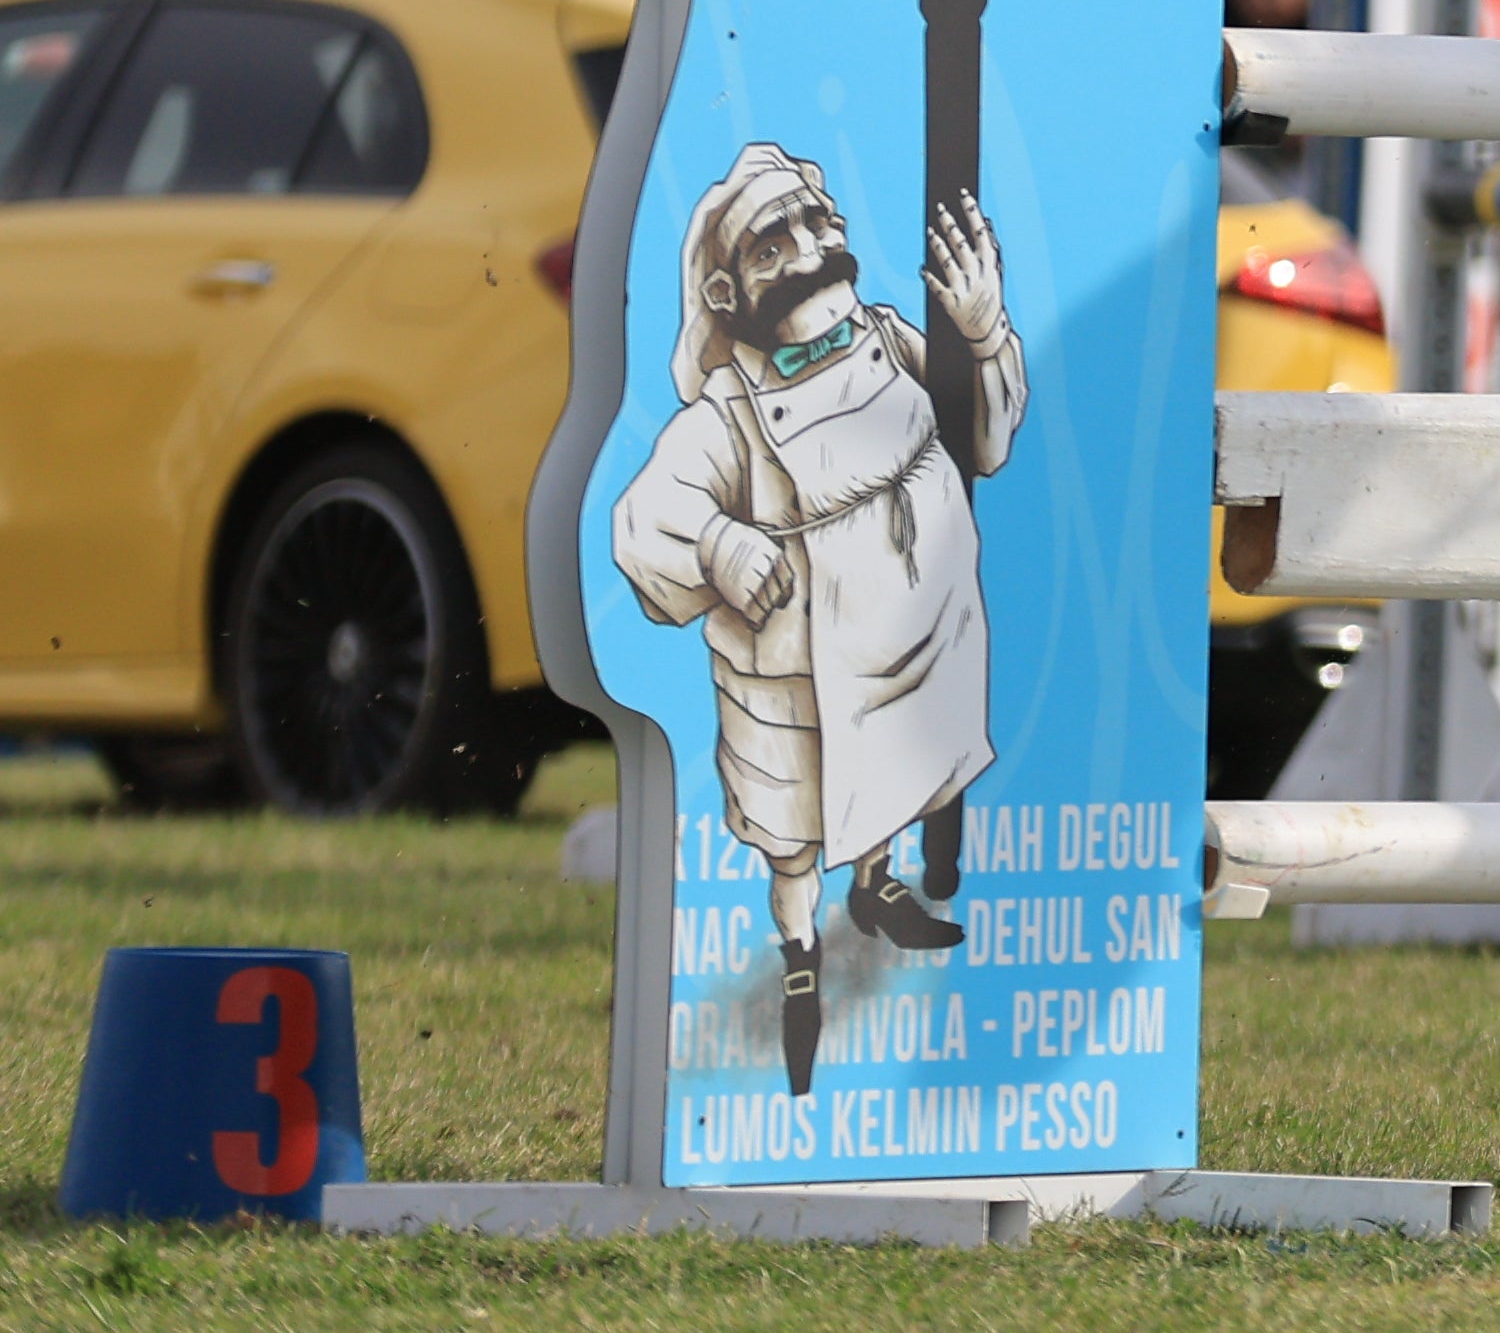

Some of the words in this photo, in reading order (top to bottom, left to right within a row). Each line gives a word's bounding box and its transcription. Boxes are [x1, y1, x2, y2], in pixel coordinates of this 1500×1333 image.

[1057, 801, 1181, 872] DEGUL
[672, 905, 752, 976] NAC
[966, 895, 1094, 968] DEHUL
[1104, 892, 1183, 964] SAN
[816, 992, 968, 1066] MIVOLA
[1012, 985, 1167, 1059] PEPLOM
[211, 965, 320, 1197] 3
[680, 1092, 818, 1165] LUMOS
[831, 1085, 982, 1159] KELMIN
[994, 1079, 1119, 1153] PESSO
